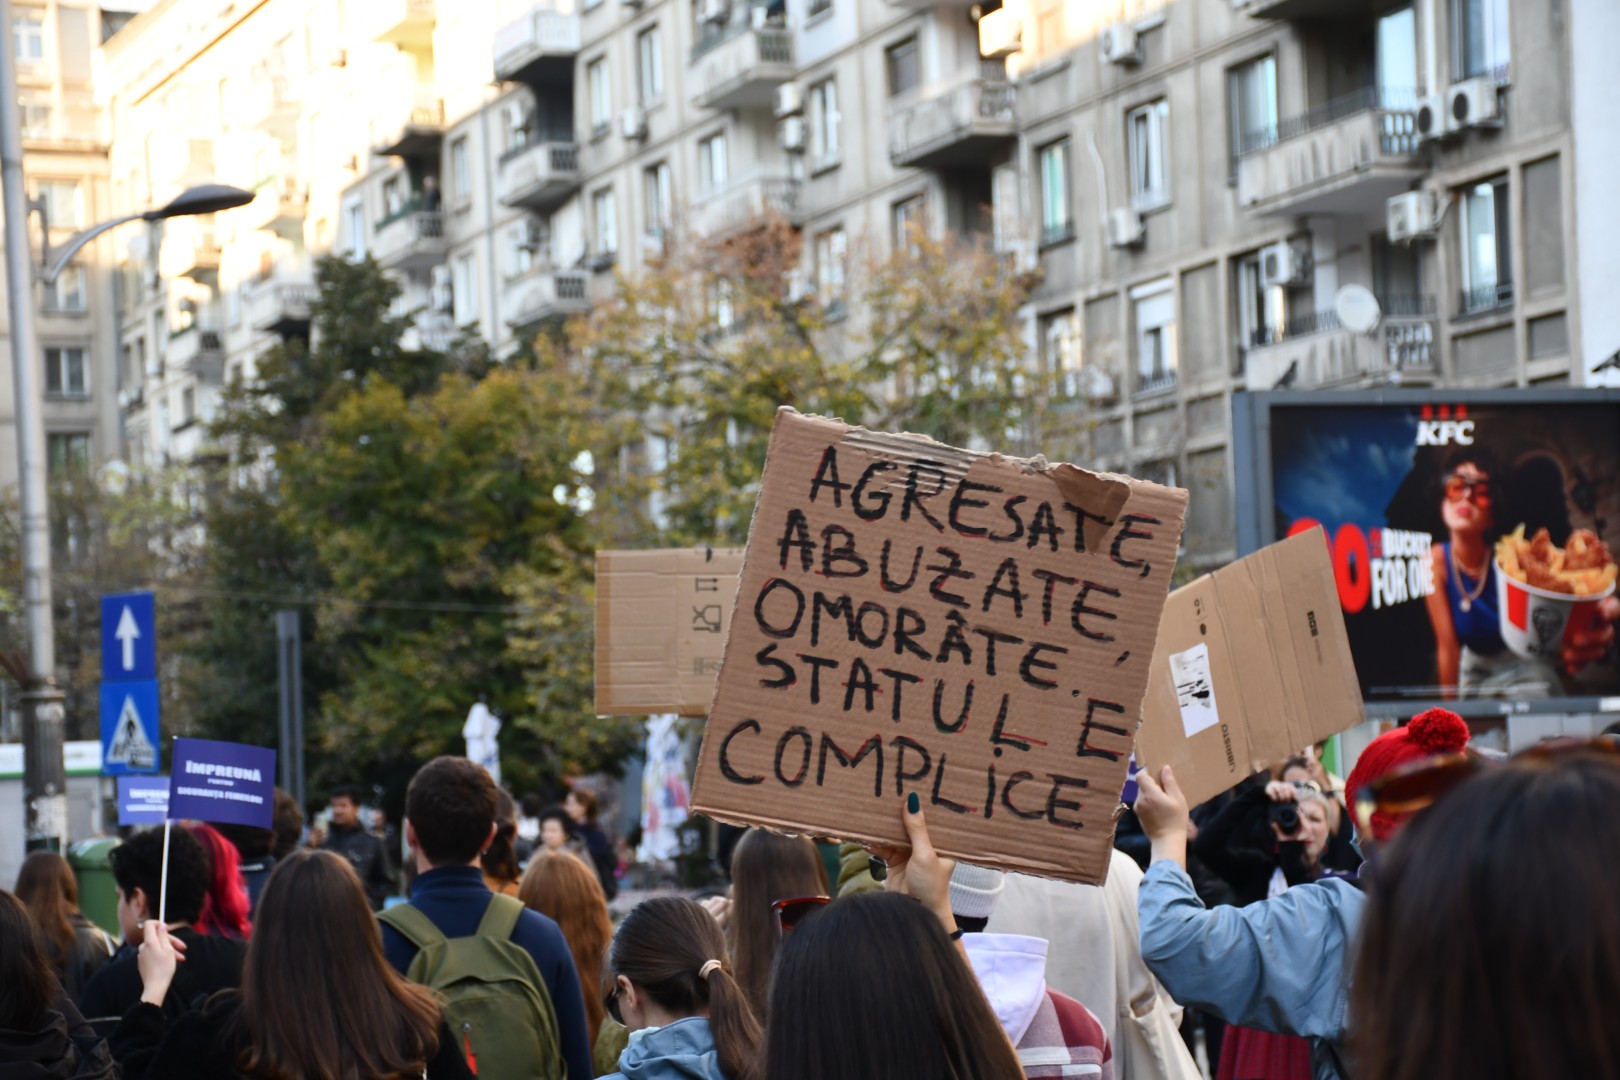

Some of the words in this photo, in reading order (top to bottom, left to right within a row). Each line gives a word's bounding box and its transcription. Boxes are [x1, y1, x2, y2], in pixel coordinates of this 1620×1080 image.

[1416, 420, 1475, 445] KFC
[808, 446, 1162, 578] AGRESATE,
[1370, 558, 1408, 610] FOR
[1408, 558, 1436, 600] ONE
[755, 643, 1048, 752] STATUL
[1076, 697, 1132, 762] E
[718, 719, 1089, 830] COMPLICE
